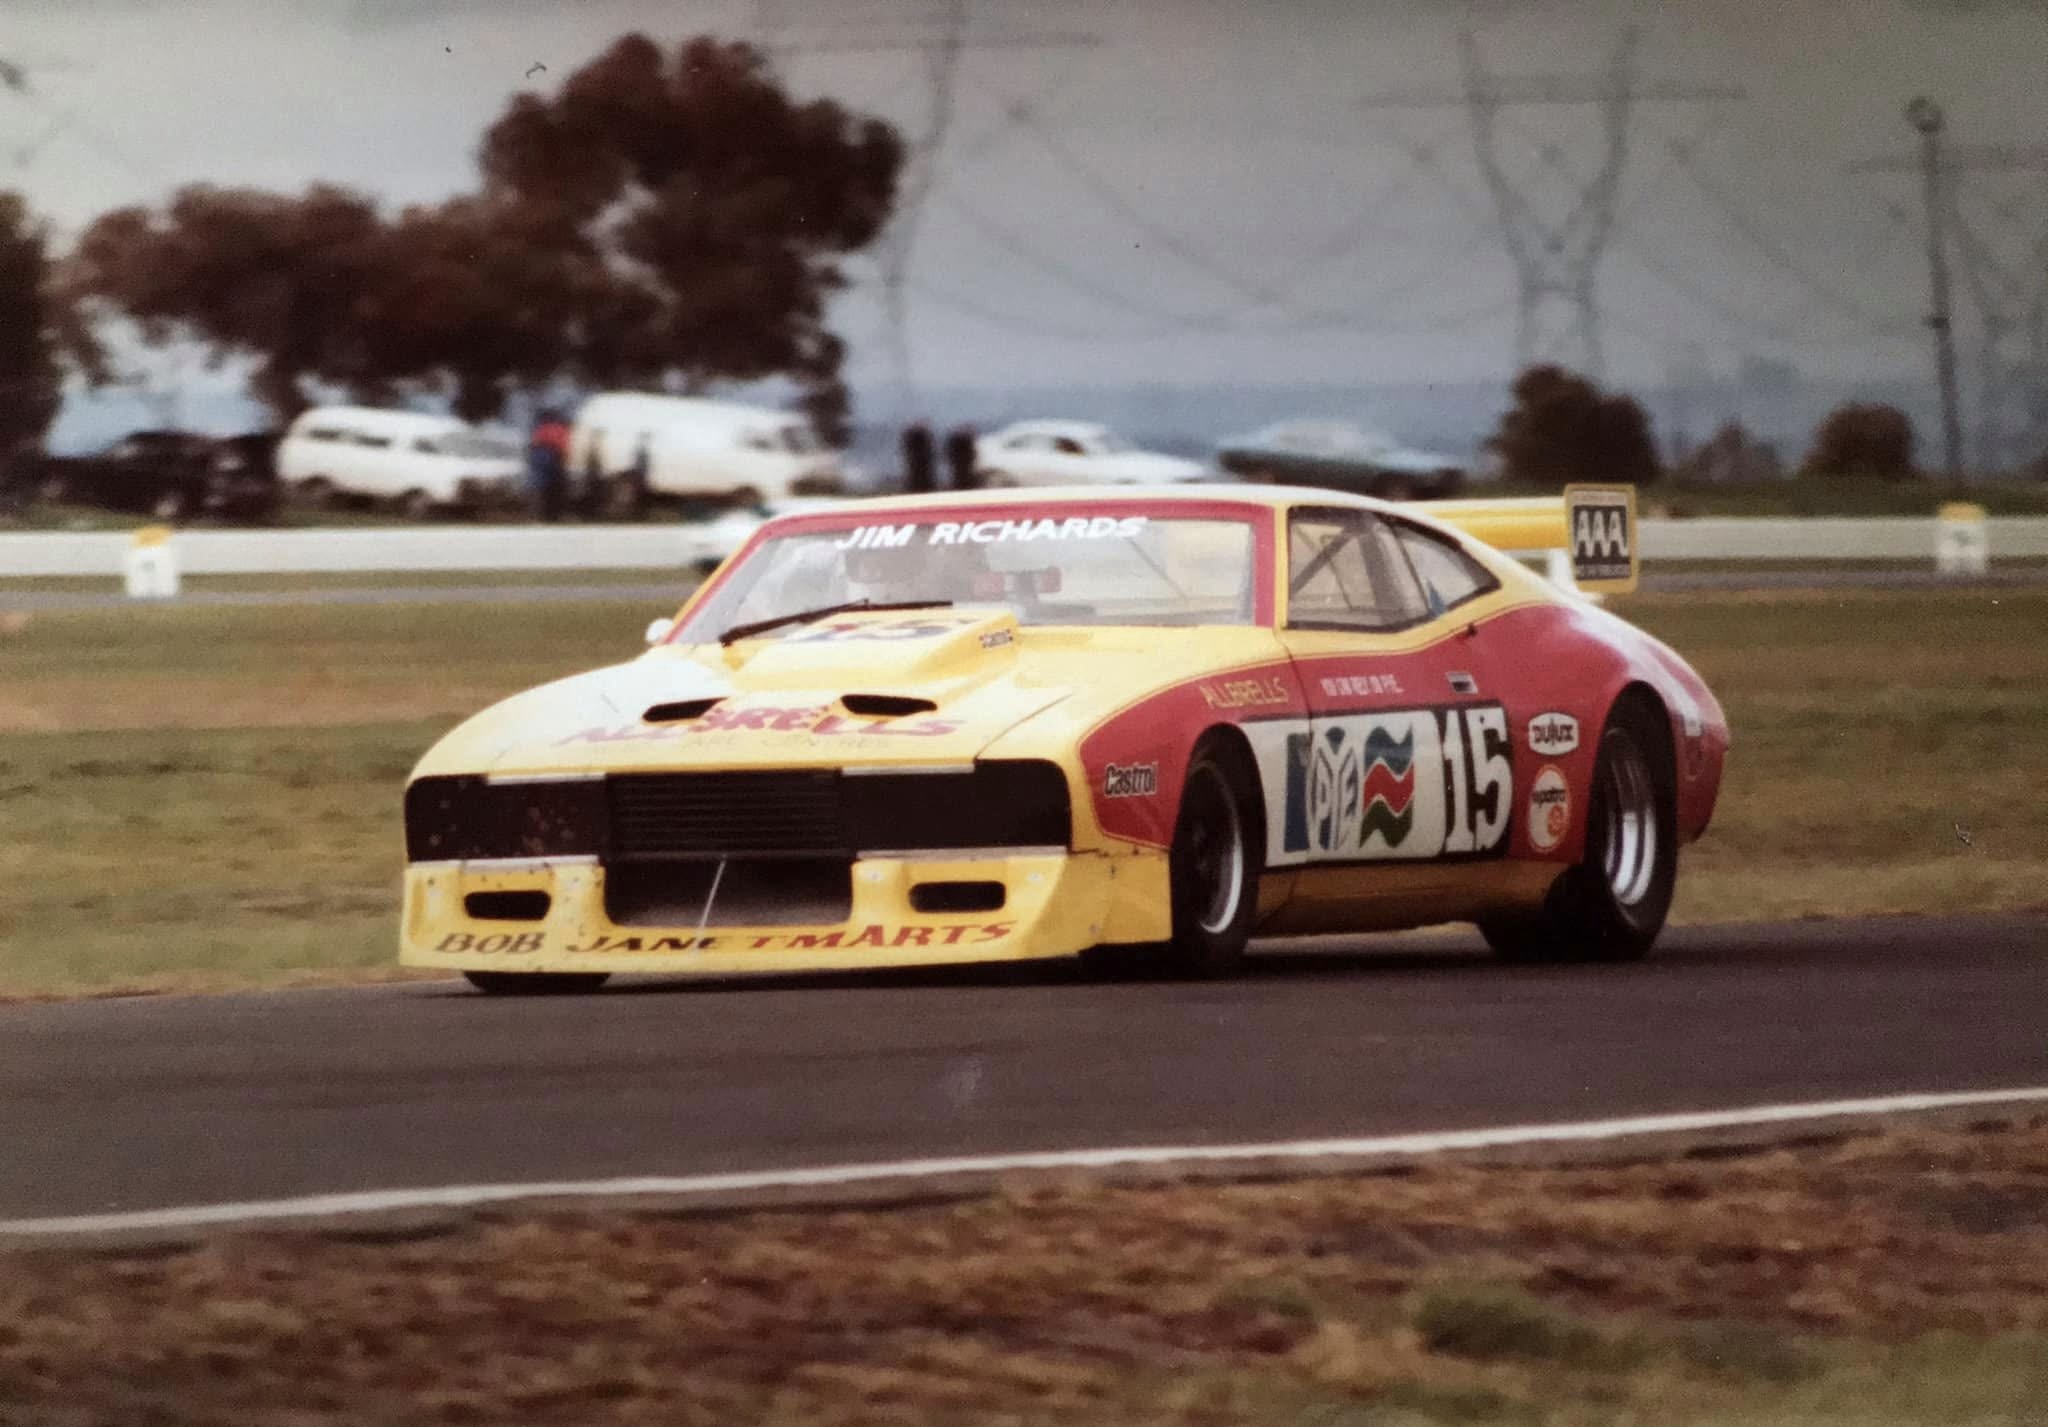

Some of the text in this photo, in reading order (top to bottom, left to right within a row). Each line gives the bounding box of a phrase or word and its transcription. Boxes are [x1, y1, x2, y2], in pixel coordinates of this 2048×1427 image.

[835, 516, 1149, 549] JIM RICHARDS
[1104, 762, 1160, 797] Castrol
[1437, 707, 1513, 852] 15
[434, 932, 546, 954] BOB
